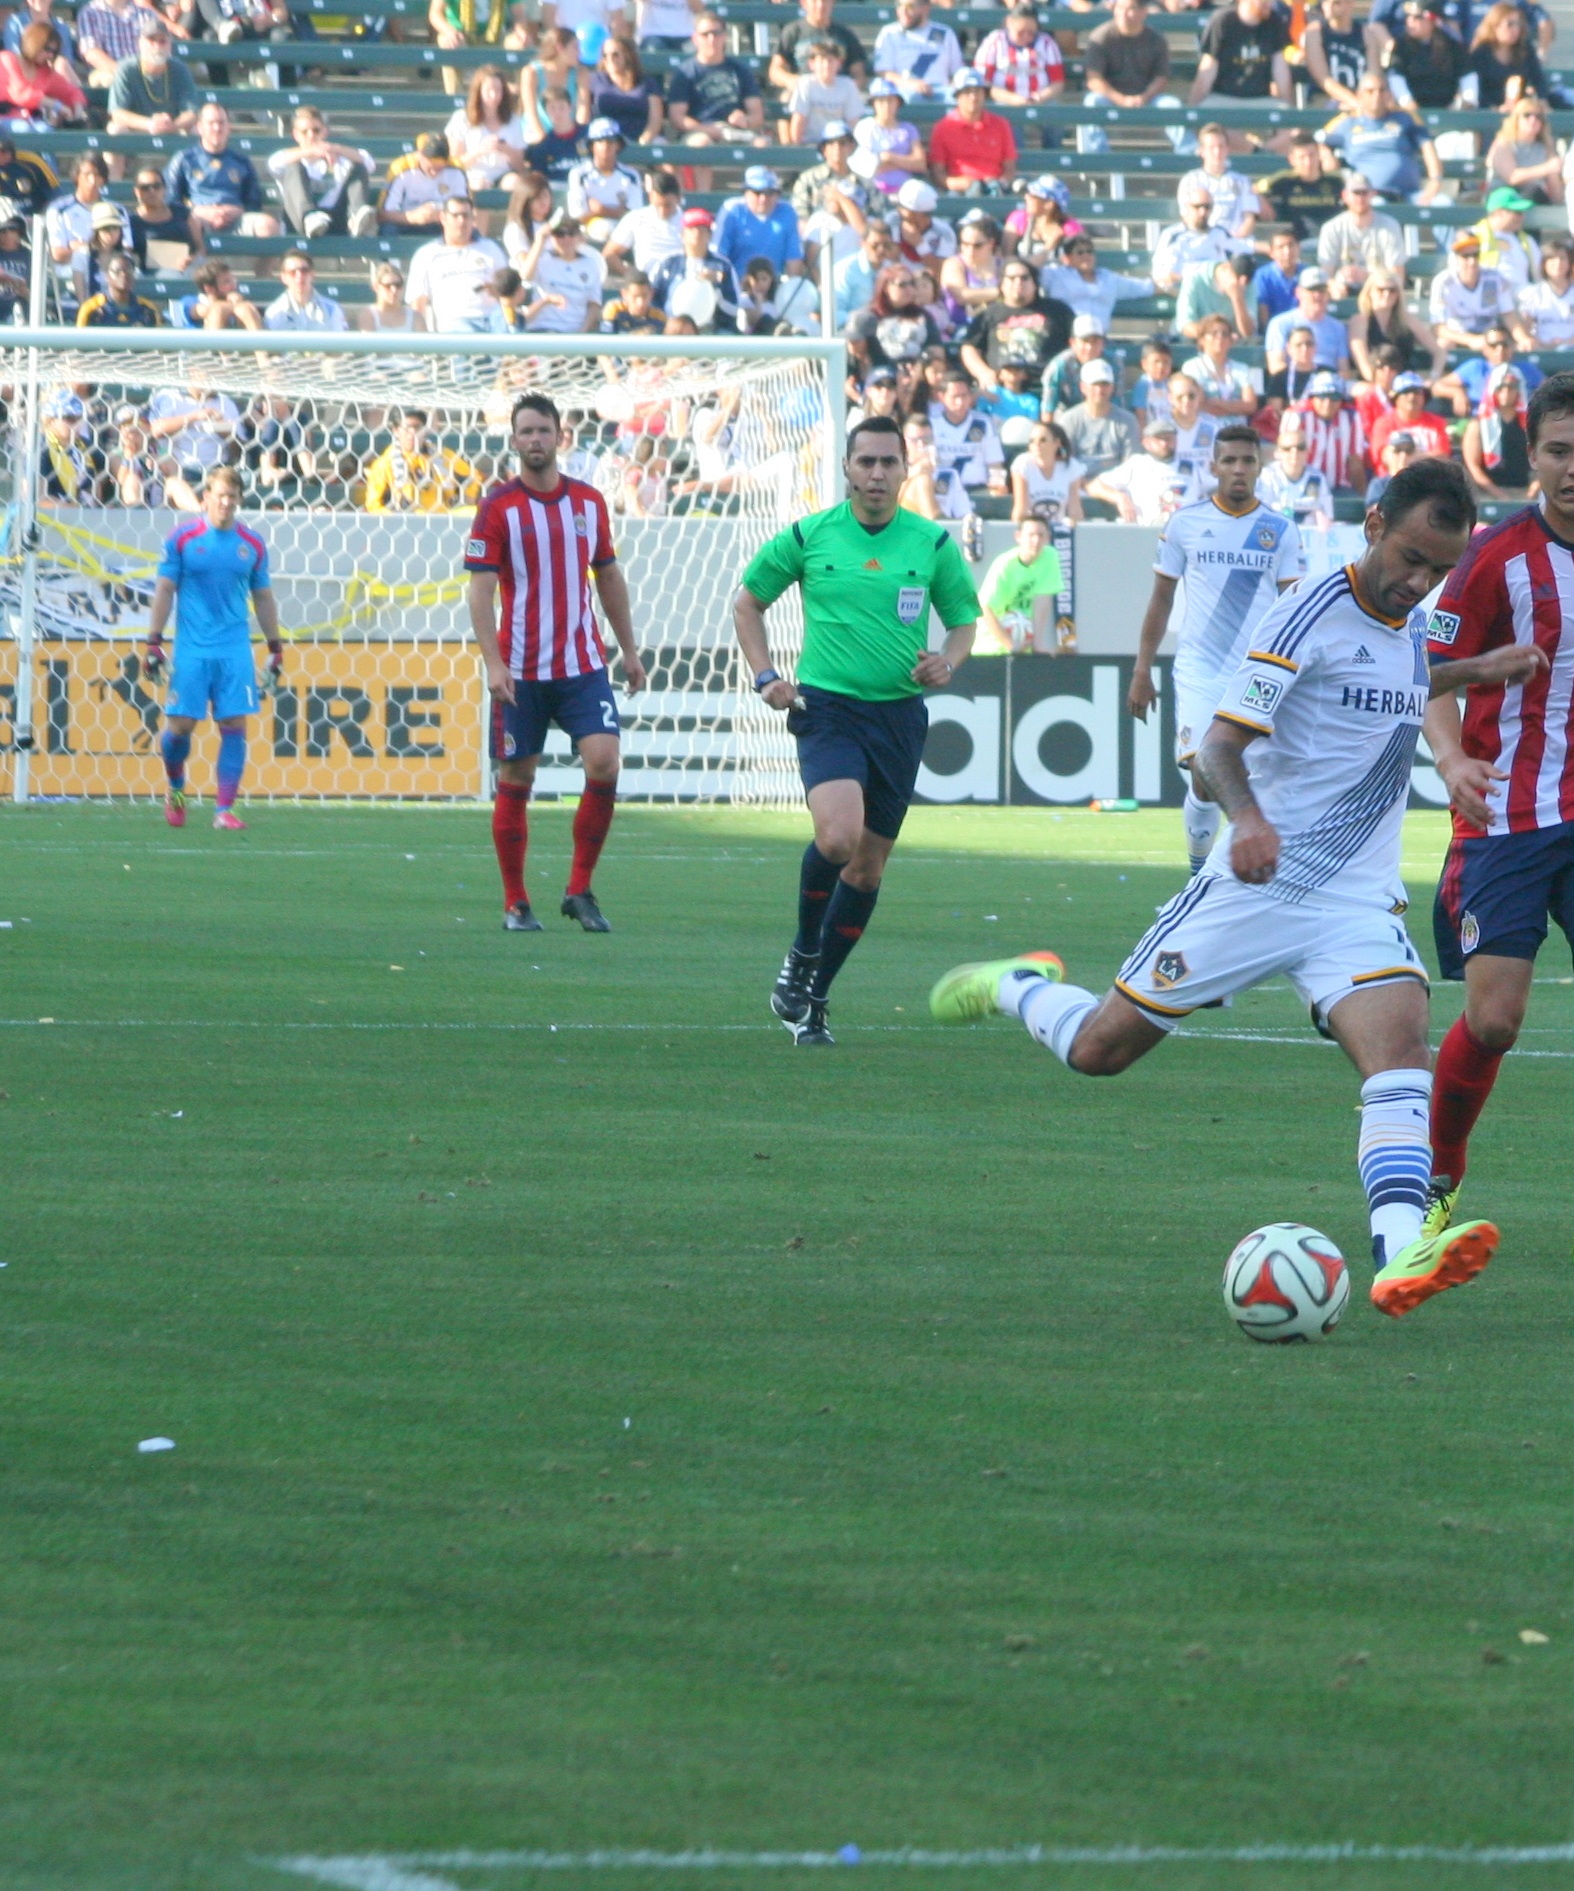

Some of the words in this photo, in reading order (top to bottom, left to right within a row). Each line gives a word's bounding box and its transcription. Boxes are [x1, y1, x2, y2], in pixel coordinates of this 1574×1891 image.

[1197, 550, 1275, 569] HERBALIFE
[1428, 630, 1453, 642] MLS
[1243, 696, 1271, 710] MLS
[1342, 686, 1428, 718] HERBAL
[262, 685, 445, 758] IRE
[600, 700, 617, 728] 2
[1159, 960, 1178, 981] LA
